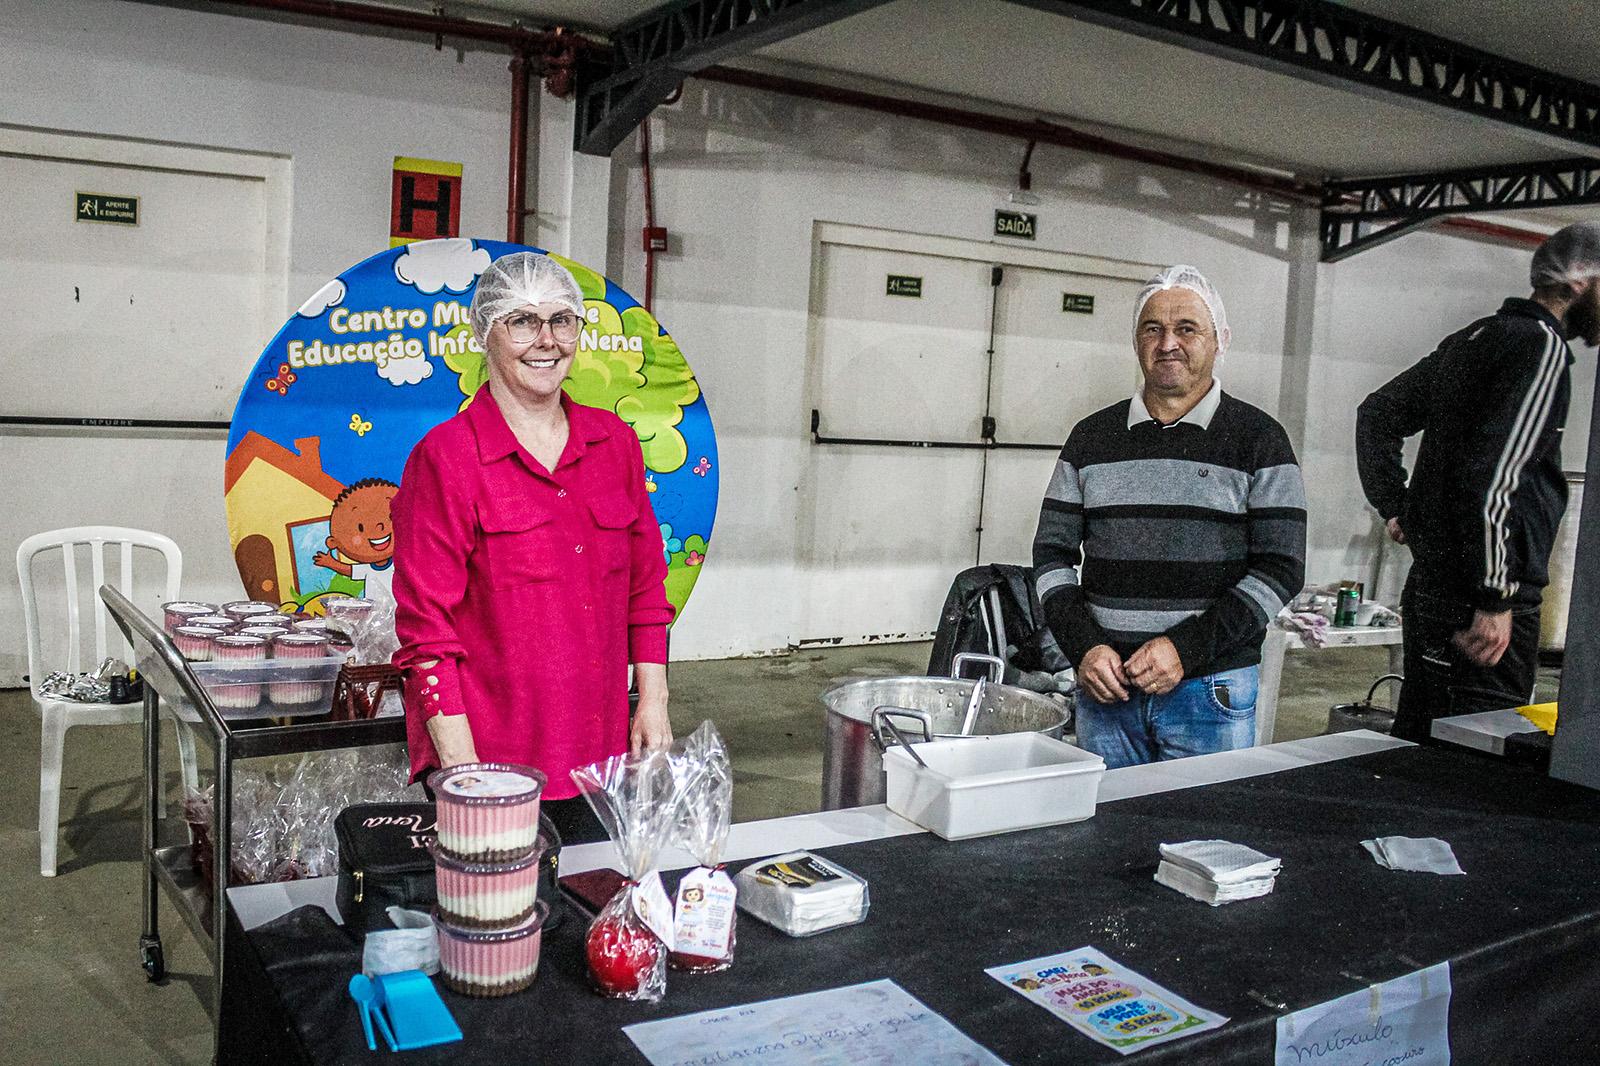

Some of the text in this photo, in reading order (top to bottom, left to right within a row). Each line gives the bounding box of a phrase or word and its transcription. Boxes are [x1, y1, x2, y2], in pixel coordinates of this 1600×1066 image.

[400, 176, 451, 236] H
[997, 217, 1033, 235] SAÍDA
[331, 307, 427, 334] Centro
[288, 333, 423, 368] Educação
[580, 329, 643, 352] Nena
[1055, 980, 1108, 998] MAÇÃ DO
[1097, 1005, 1126, 1019] BOLO
